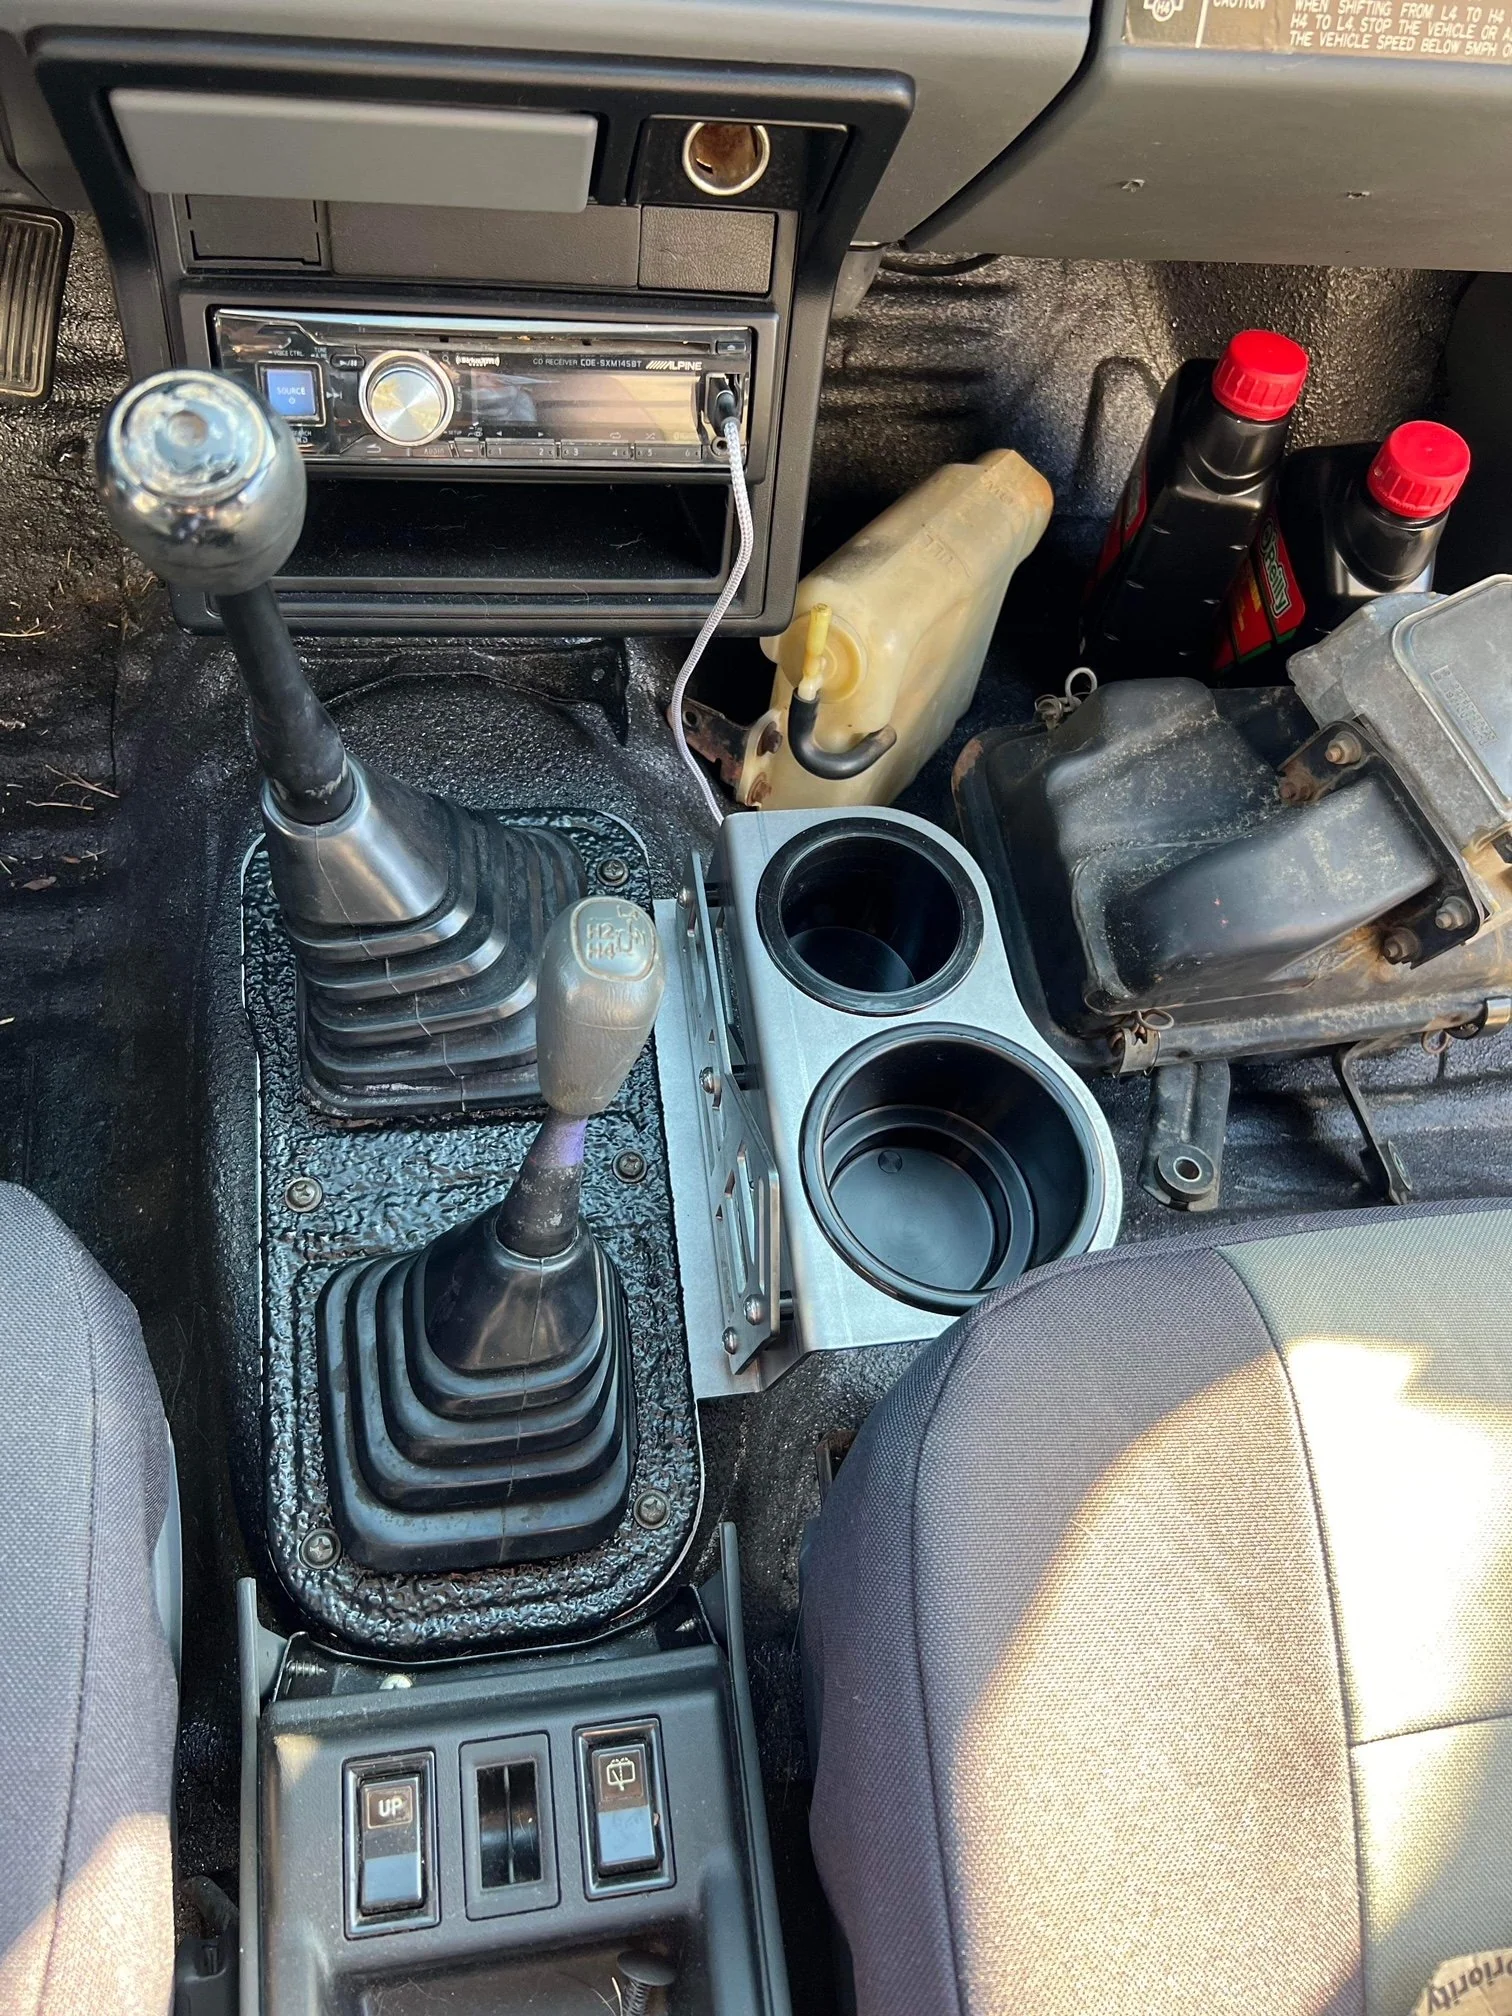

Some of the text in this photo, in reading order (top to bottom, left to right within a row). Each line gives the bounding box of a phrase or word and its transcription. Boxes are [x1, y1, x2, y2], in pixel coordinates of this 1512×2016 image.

[1213, 0, 1266, 10] CAUTION
[1295, 0, 1505, 24] WHEN SHIFTING FROM L4 TO H4
[1290, 12, 1309, 29] H4
[1315, 14, 1332, 31] TO
[1360, 16, 1392, 34] STOP
[1398, 18, 1422, 36] THE
[1428, 20, 1477, 39] VEHICLE
[1481, 24, 1498, 41] OR
[1290, 29, 1314, 47] THE
[1320, 31, 1372, 49] VEHICLE
[1376, 34, 1416, 52] SPEED
[1421, 36, 1462, 54] BELOW
[1465, 40, 1498, 57] 5MPH
[532, 358, 544, 366] CD
[661, 360, 703, 371] ALPINE
[276, 387, 306, 397] SOURCE
[586, 922, 614, 941] H2
[586, 941, 616, 960] H4
[378, 1797, 403, 1818] UP
